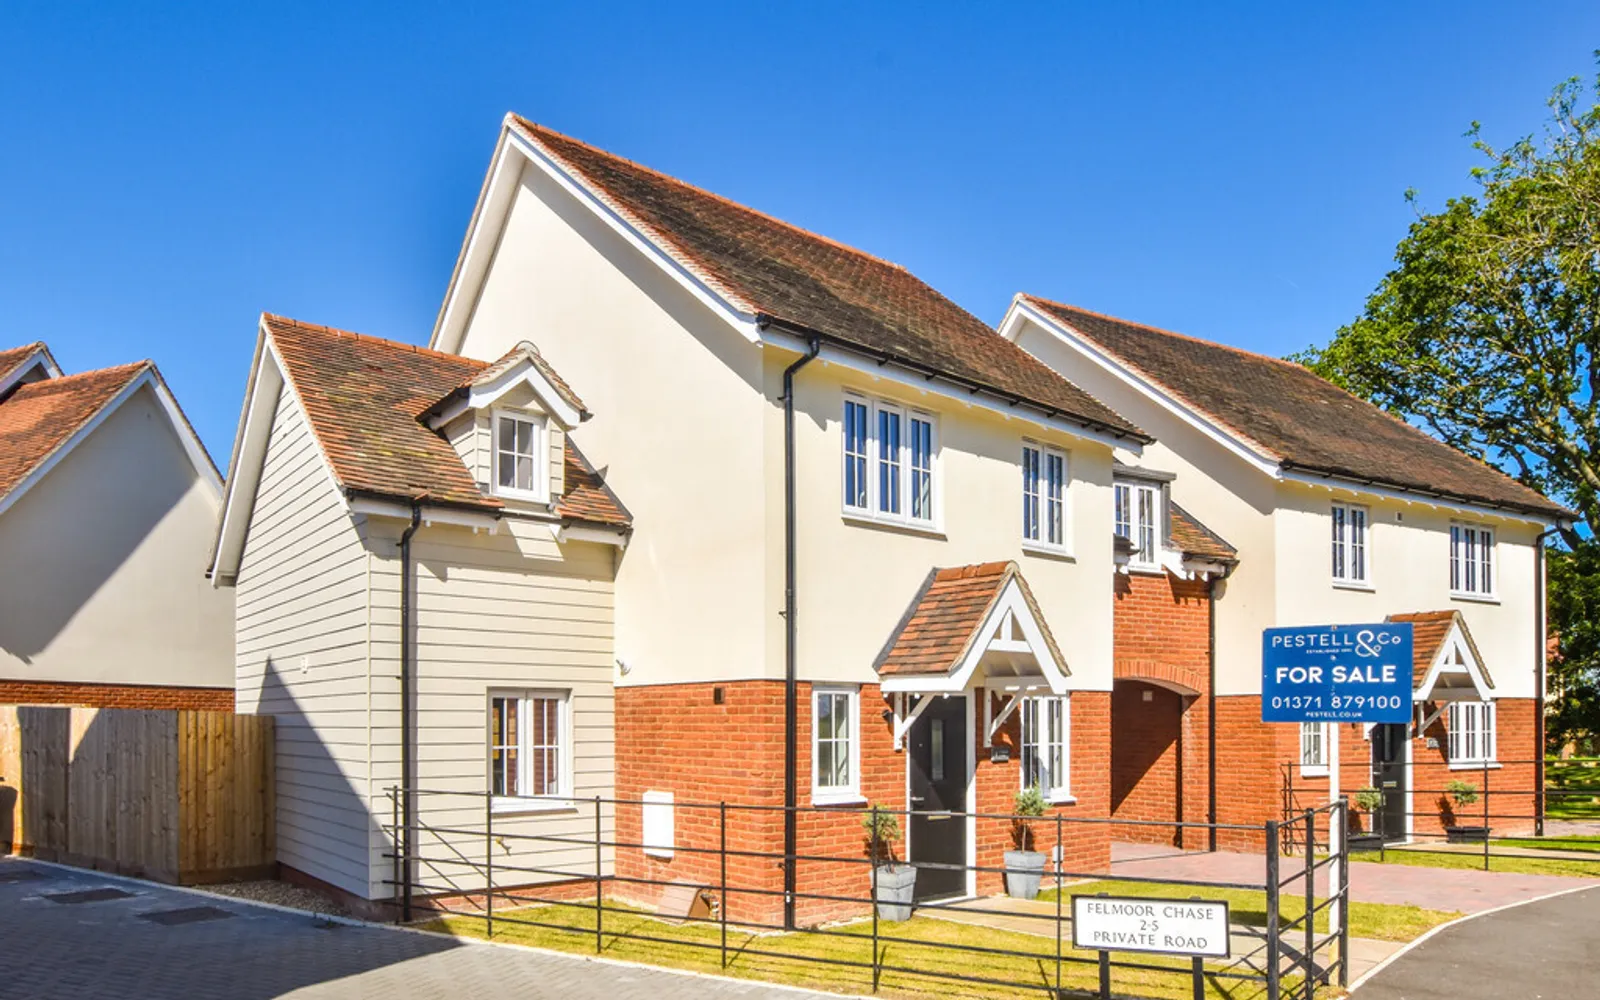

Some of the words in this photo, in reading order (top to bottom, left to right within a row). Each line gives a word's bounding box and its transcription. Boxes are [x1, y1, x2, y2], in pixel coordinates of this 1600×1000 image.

[1272, 634, 1353, 648] PESTELL
[1377, 632, 1401, 645] Co
[1276, 667, 1323, 684] FOR
[1332, 665, 1396, 683] SALE
[1272, 697, 1322, 709] 01371
[1331, 696, 1401, 709] 879100
[1087, 903, 1155, 917] FELMOOR
[1163, 907, 1214, 920] CHASE
[1140, 920, 1159, 932] 2-5
[1093, 931, 1156, 946] PRIVATE
[1164, 936, 1208, 949] ROAD
